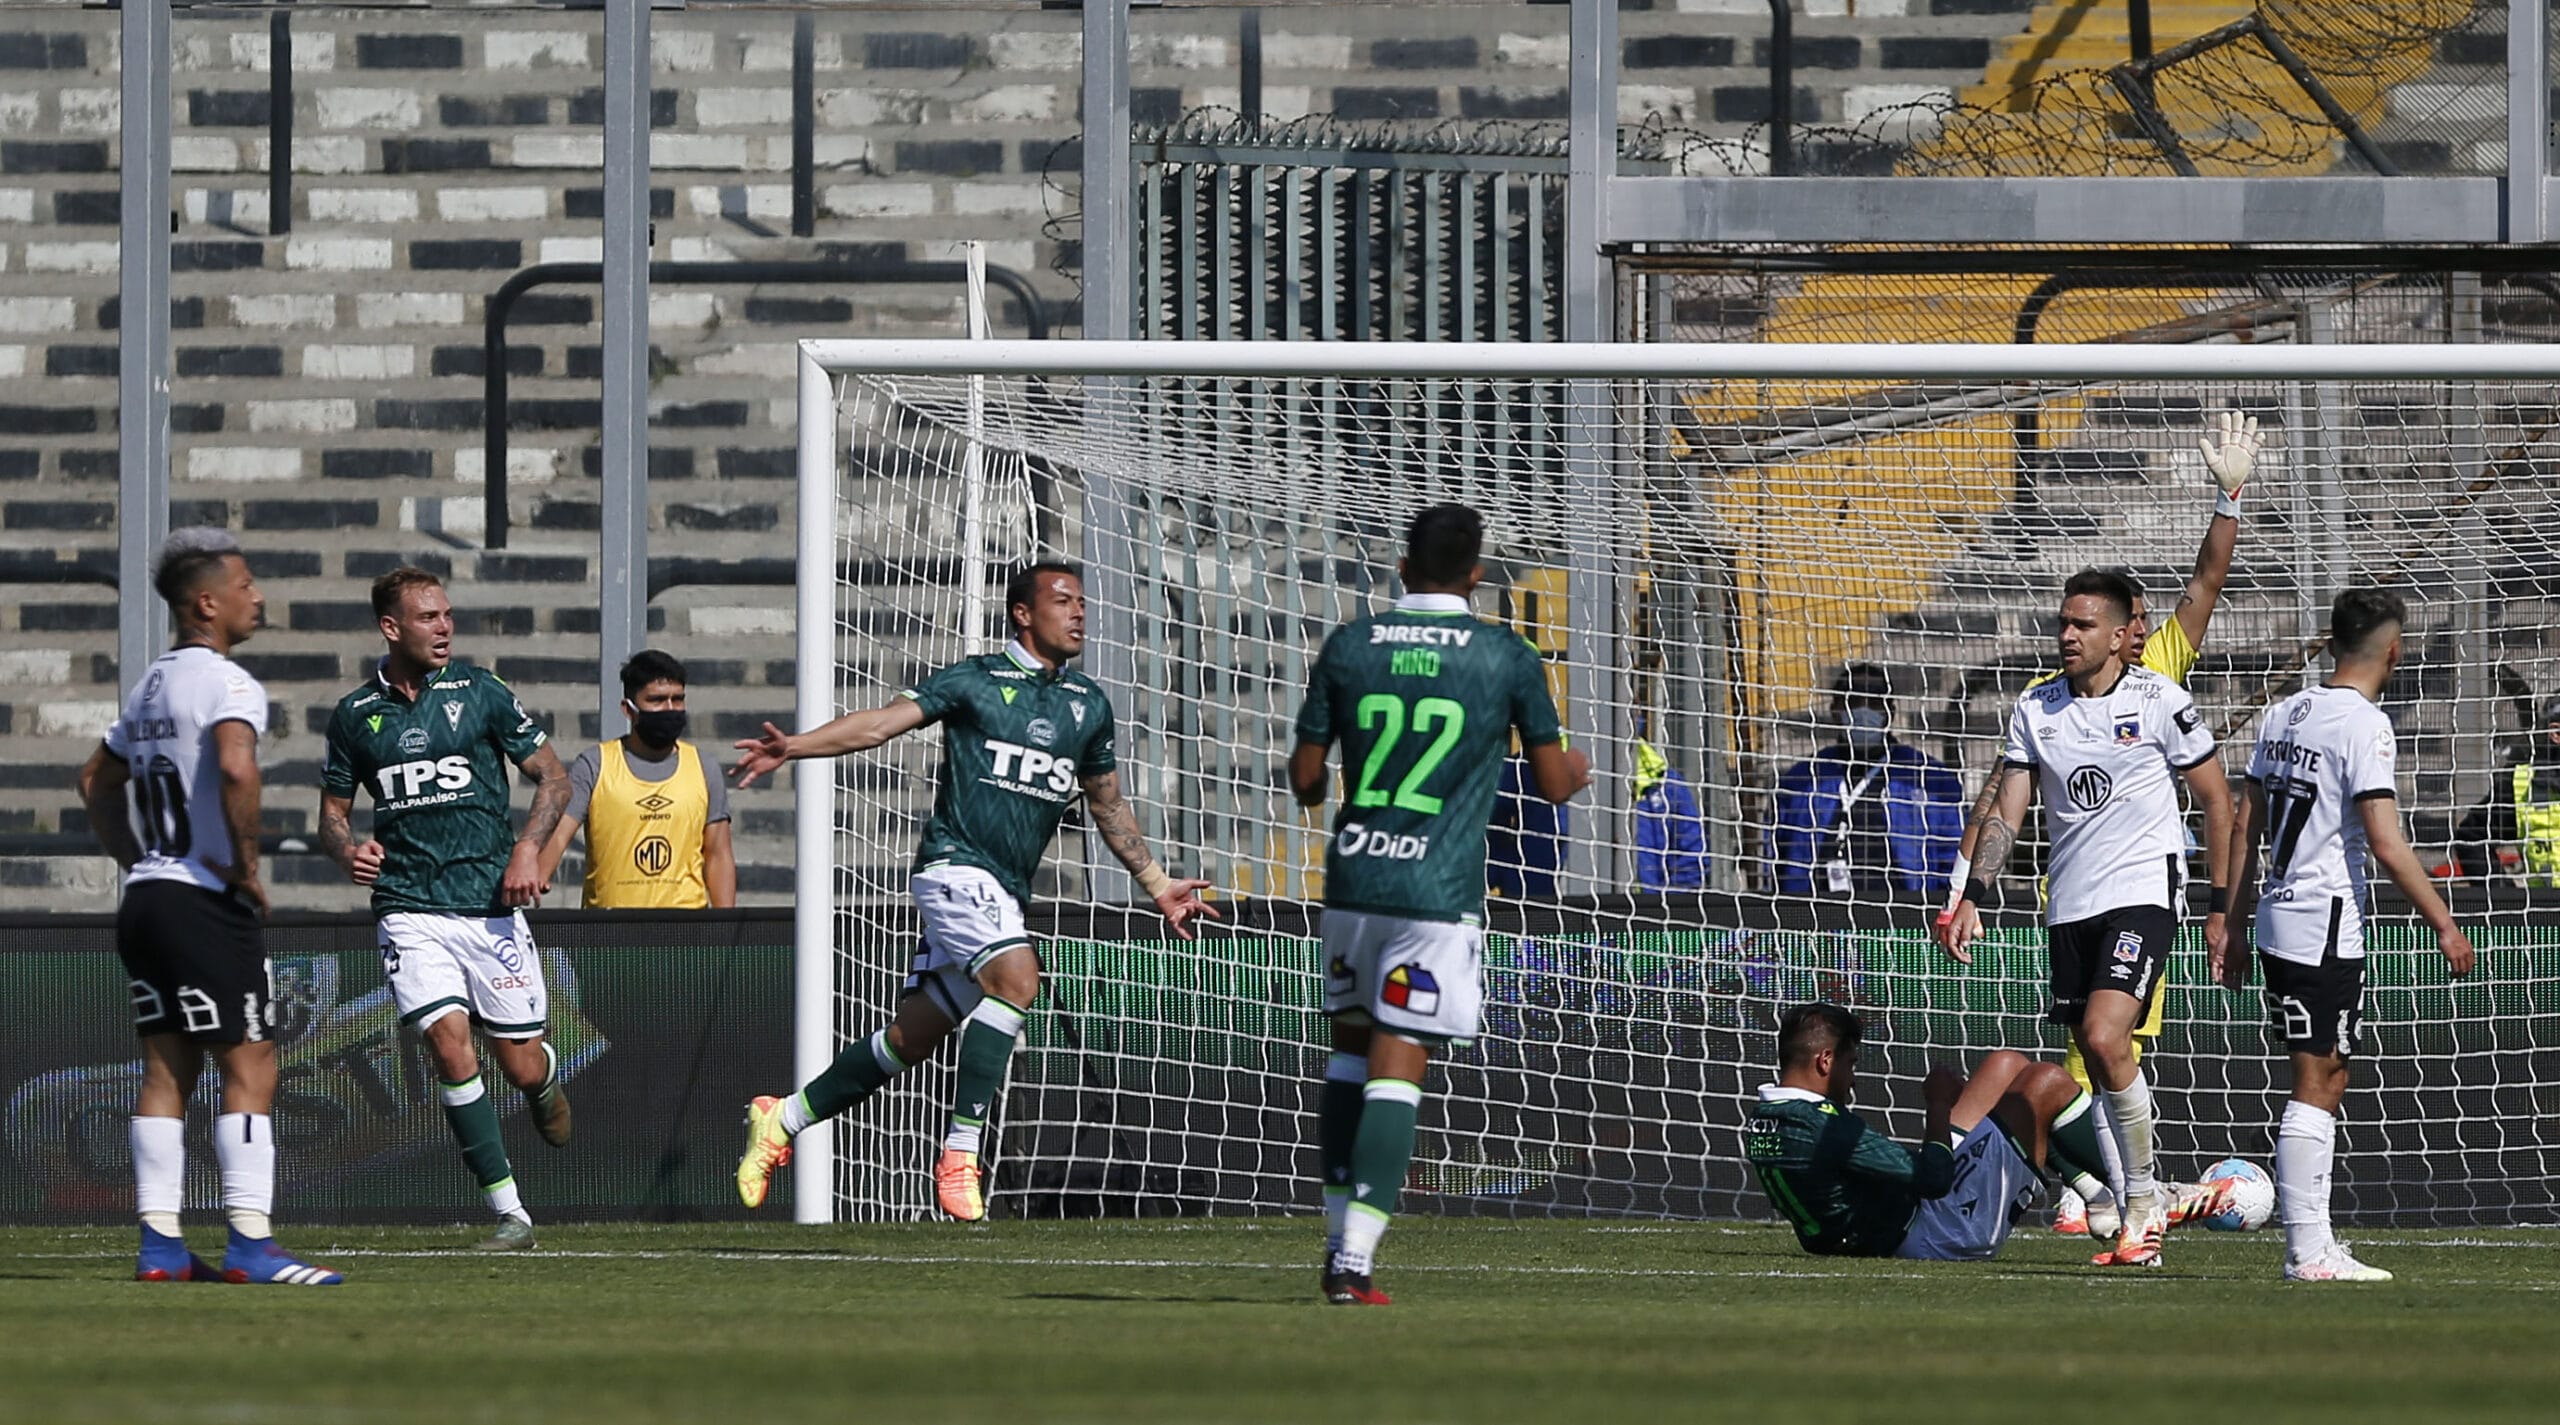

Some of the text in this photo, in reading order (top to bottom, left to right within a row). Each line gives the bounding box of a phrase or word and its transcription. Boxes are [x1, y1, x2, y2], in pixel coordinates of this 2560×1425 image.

[1370, 625, 1472, 647] DIRECTV
[1391, 648, 1441, 677] MIÑO
[984, 739, 1075, 793] TPS
[1352, 693, 1466, 815] 22
[376, 755, 472, 800] TPS
[2070, 768, 2109, 808] MG
[388, 791, 458, 811] VALPARAÍSO
[640, 812, 671, 821] umbro
